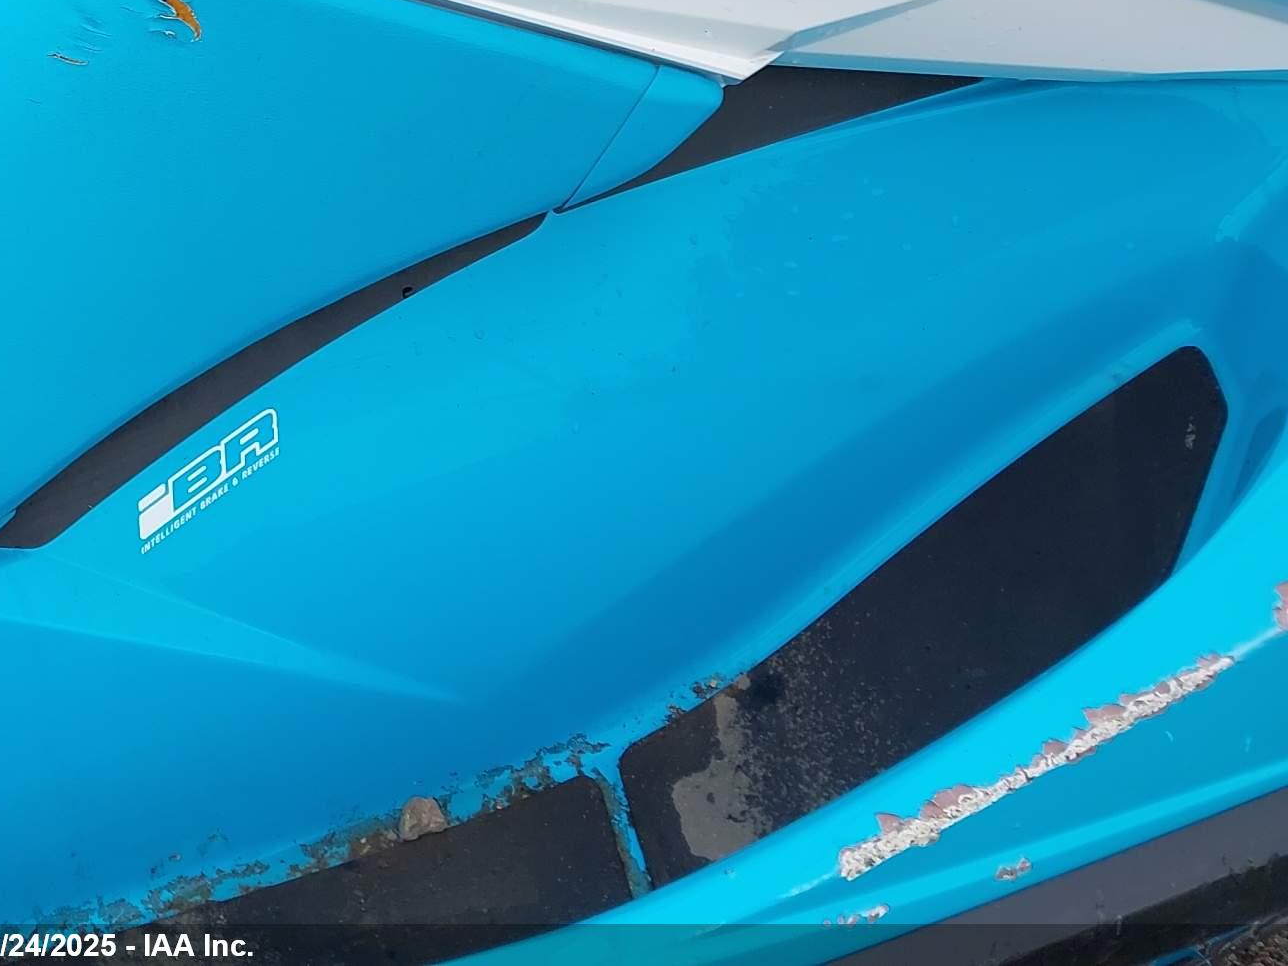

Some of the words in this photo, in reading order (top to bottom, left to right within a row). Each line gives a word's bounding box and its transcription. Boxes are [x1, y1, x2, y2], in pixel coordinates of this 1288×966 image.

[141, 507, 197, 554] INTELLIGENT
[200, 483, 229, 510] BRAKE
[242, 446, 280, 480] REVERSE
